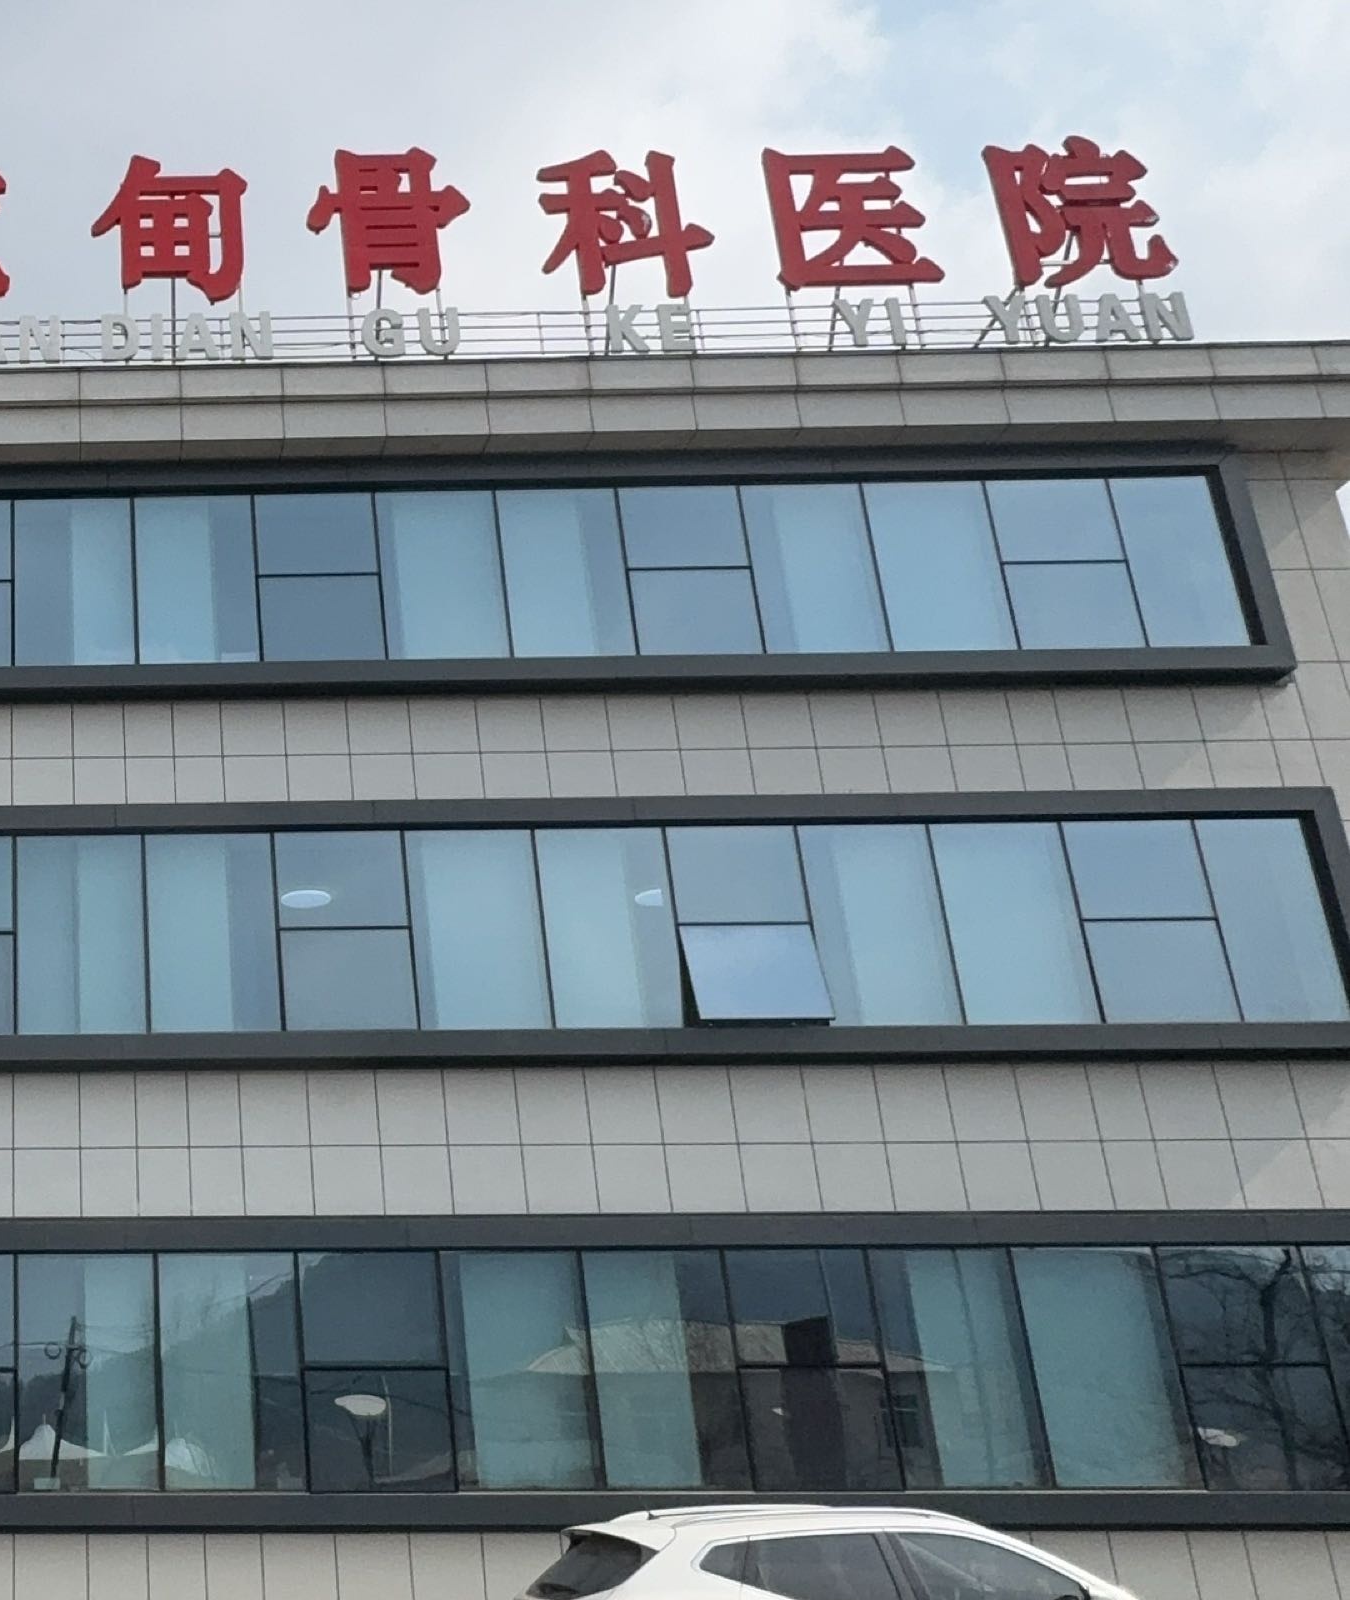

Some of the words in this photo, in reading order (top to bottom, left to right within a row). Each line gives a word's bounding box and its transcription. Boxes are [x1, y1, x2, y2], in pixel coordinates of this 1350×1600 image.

[100, 311, 274, 362] DIAN
[361, 307, 460, 357] GU
[605, 303, 695, 353] KE
[832, 297, 906, 347] YI
[982, 291, 1195, 345] YUAN
